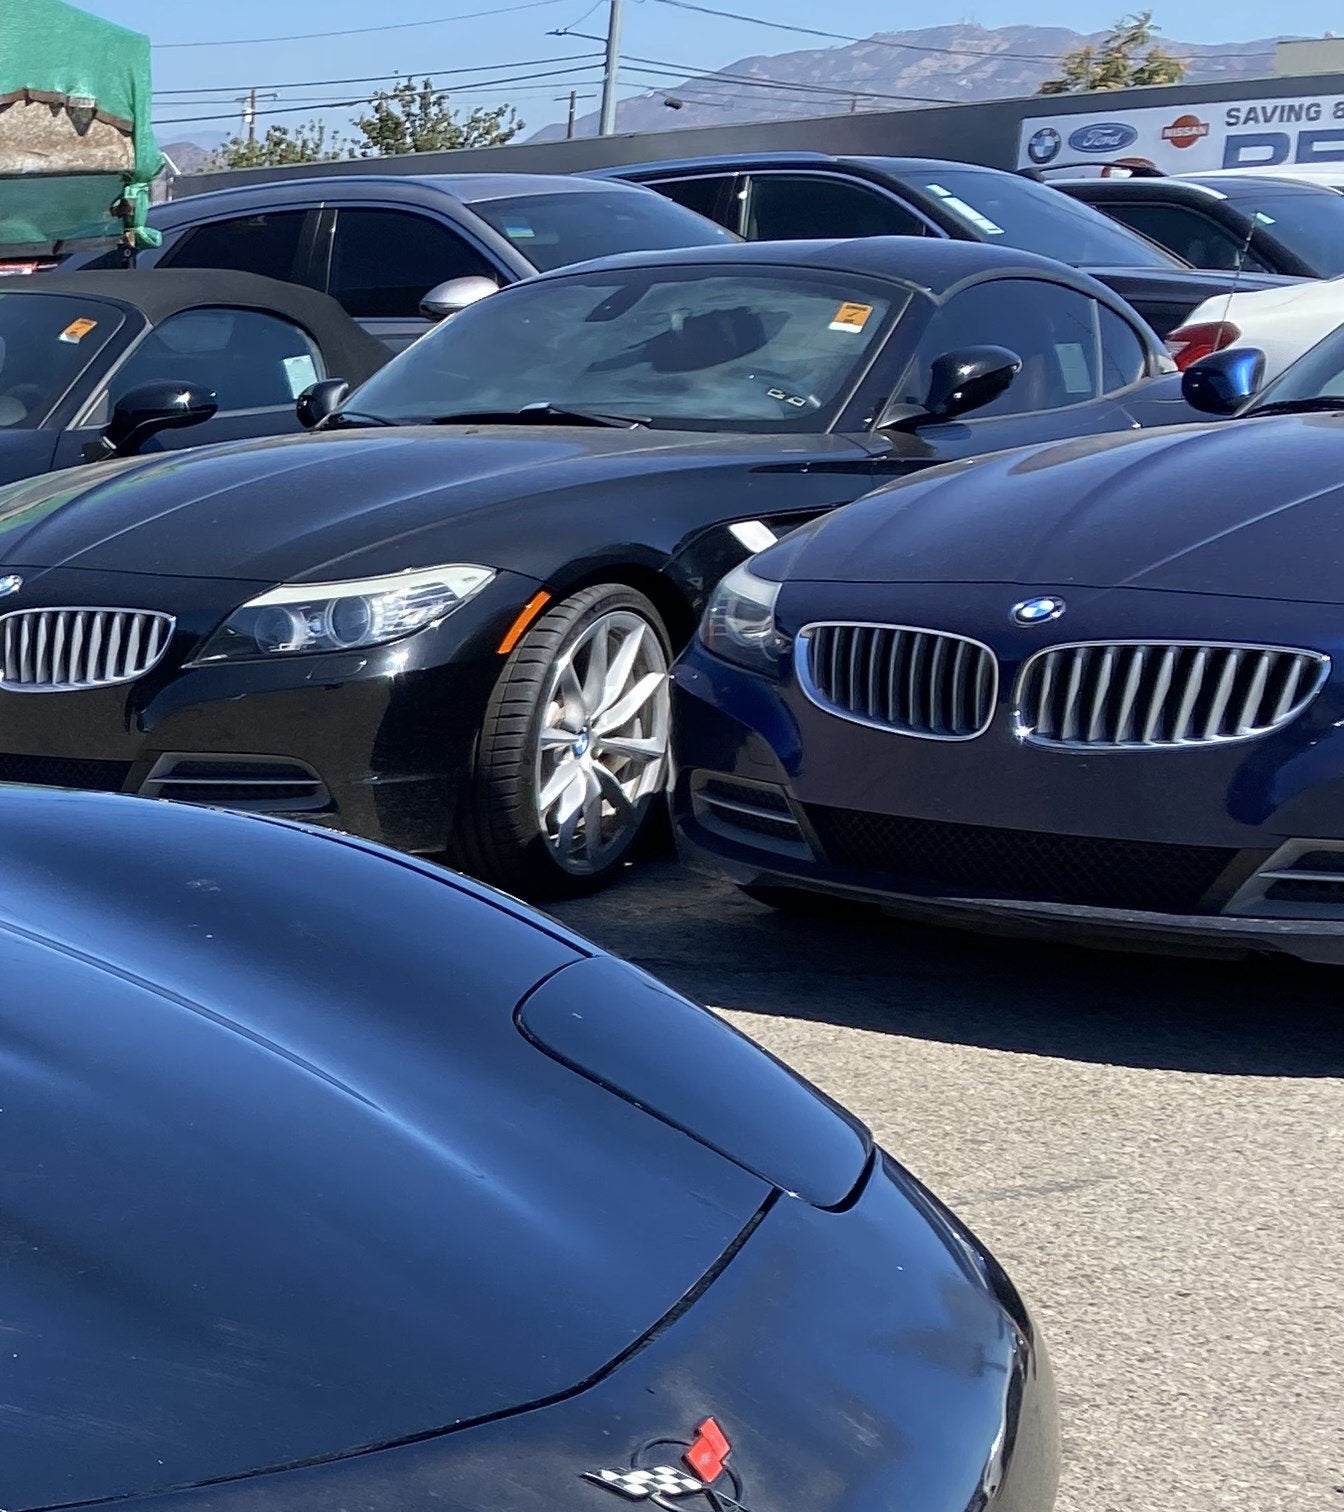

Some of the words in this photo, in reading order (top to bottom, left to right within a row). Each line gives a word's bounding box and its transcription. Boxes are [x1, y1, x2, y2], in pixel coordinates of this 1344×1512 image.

[1225, 103, 1322, 127] SAVING
[1081, 129, 1121, 147] Ford
[1164, 126, 1206, 138] NISSAN
